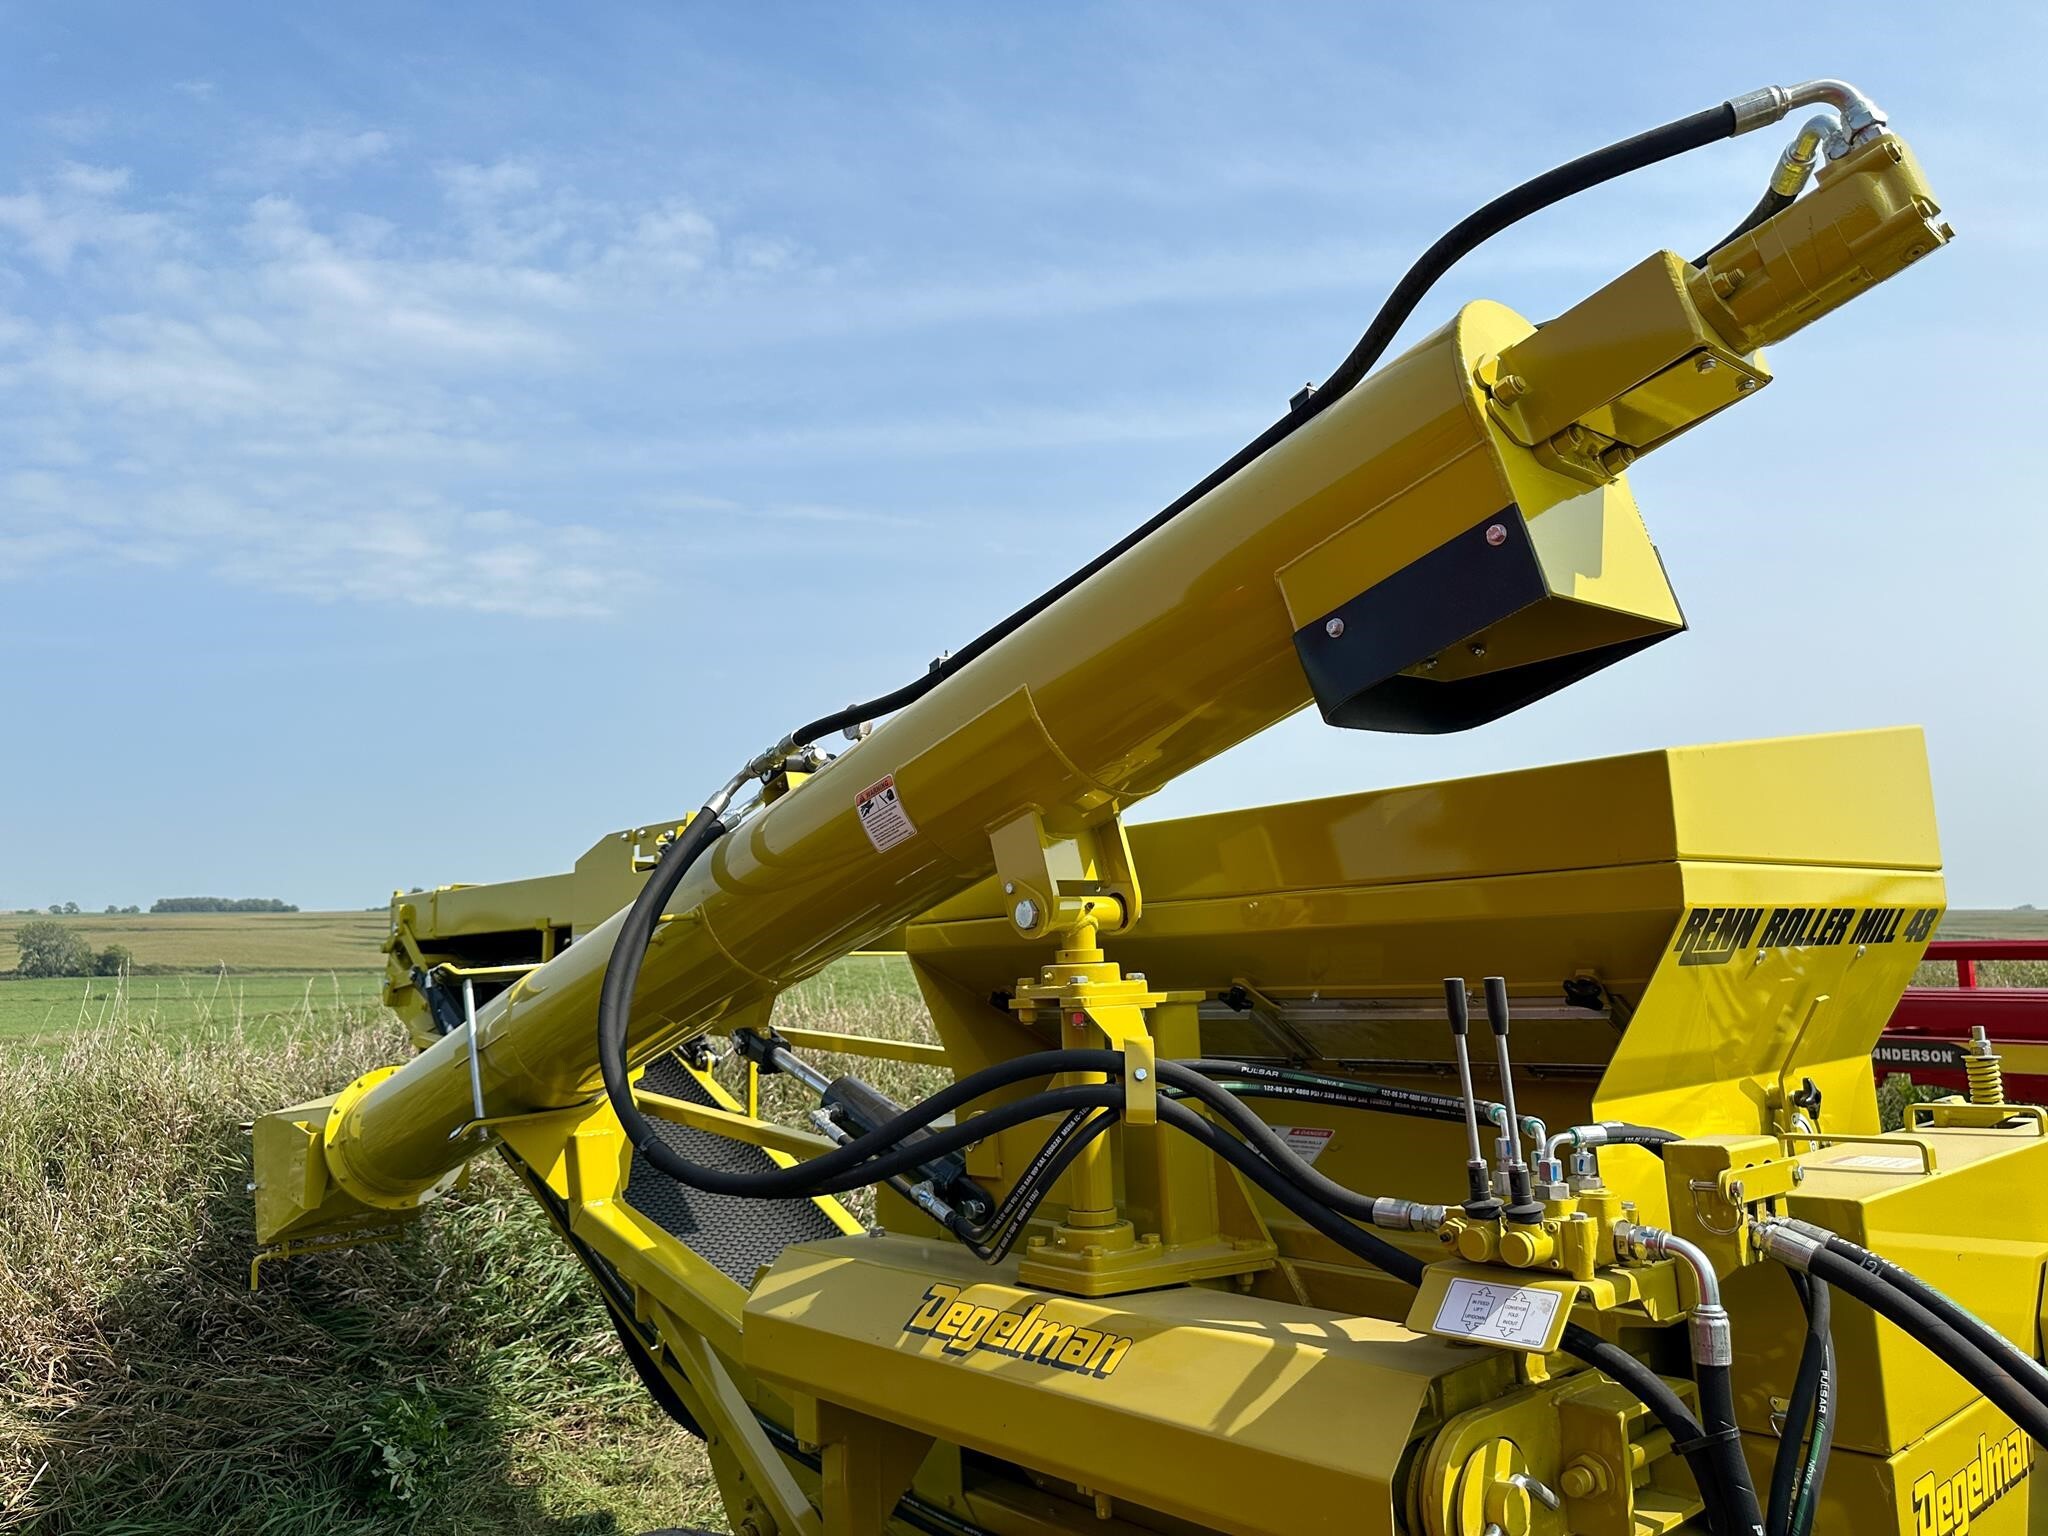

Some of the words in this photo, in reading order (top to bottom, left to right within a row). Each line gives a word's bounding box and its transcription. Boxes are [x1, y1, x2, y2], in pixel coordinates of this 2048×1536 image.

[866, 780, 889, 798] WARNING
[1674, 908, 1764, 964] RENN
[1757, 908, 1855, 948] ROLLER
[1848, 908, 1905, 944] MILL
[1903, 908, 1939, 942] 48
[1872, 1047, 1953, 1063] ANDERSON
[1241, 1066, 1280, 1078] PULSAR
[1264, 1085, 1282, 1093] 122-06
[1316, 1079, 1337, 1087] NOVA
[904, 1283, 1133, 1379] Degelman
[1818, 1369, 1829, 1414] PULSAR
